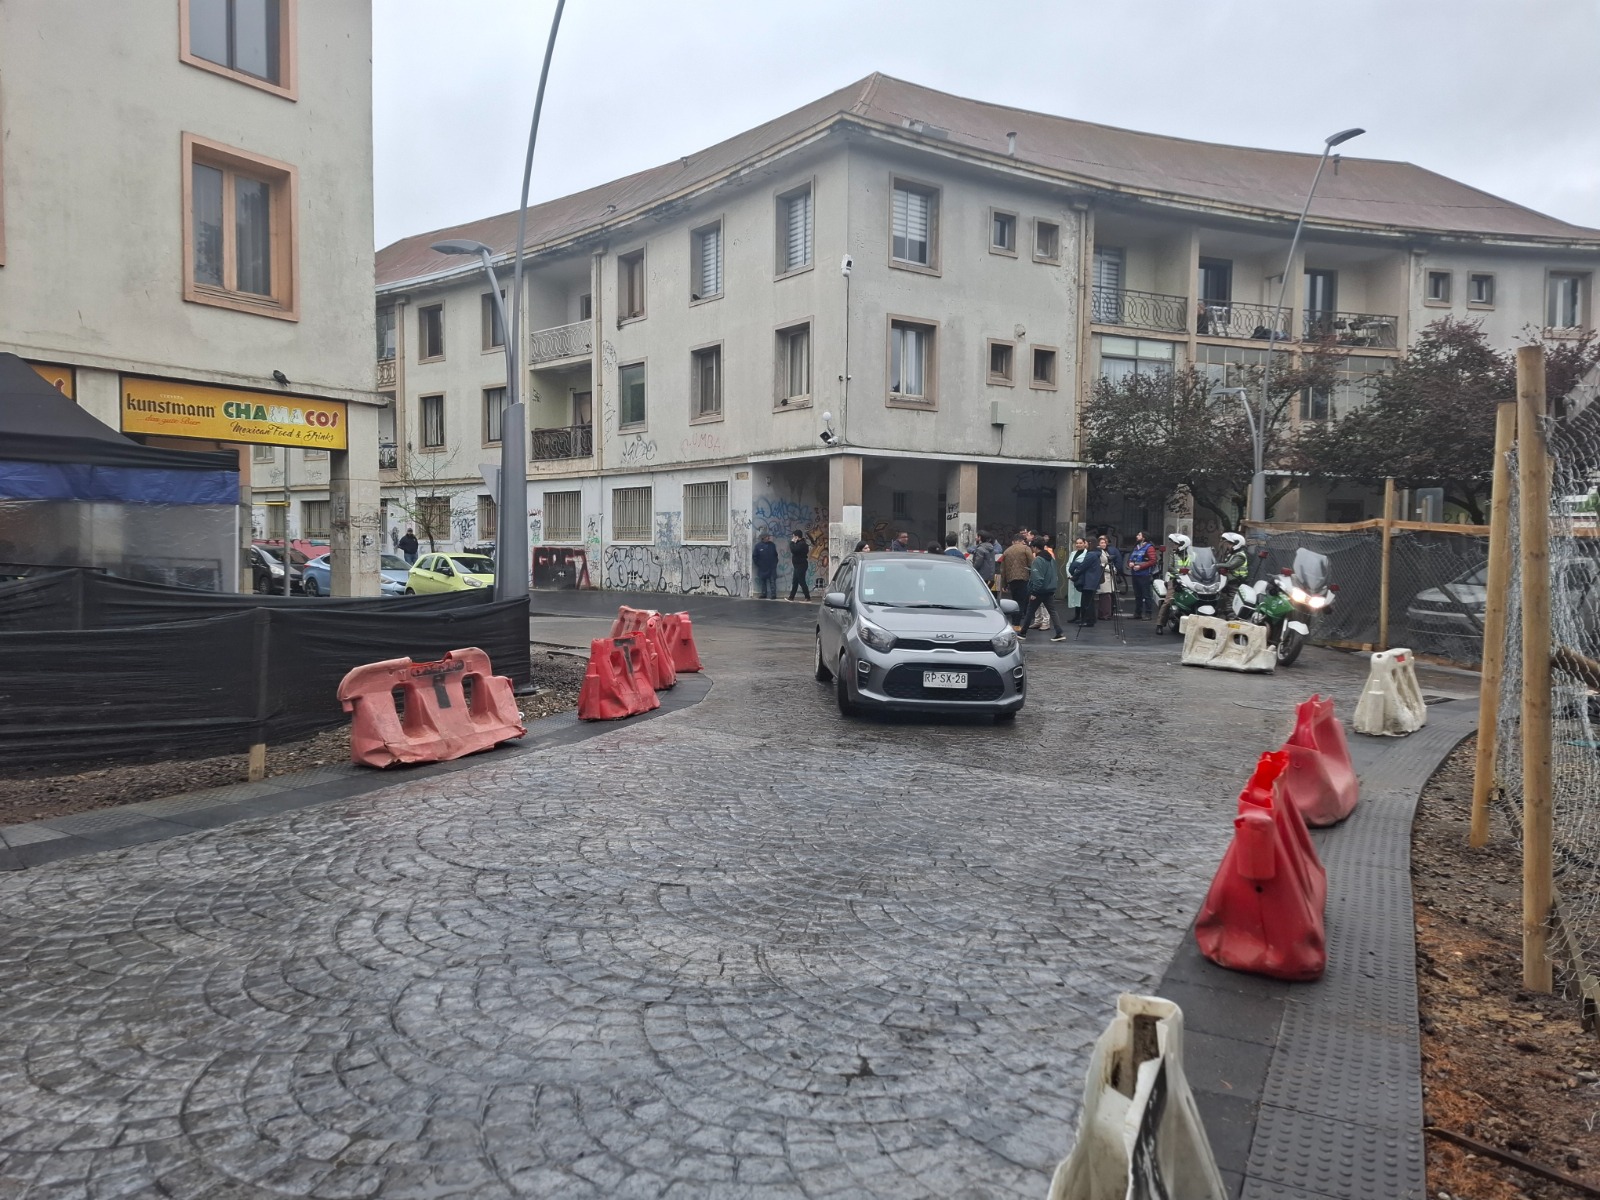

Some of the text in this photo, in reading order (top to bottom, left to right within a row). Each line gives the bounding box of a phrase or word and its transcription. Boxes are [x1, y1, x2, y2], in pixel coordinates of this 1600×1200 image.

[126, 393, 215, 418] kunstmann
[222, 401, 339, 428] CHAMACOS
[230, 421, 335, 443] Mexican Food & Drinks
